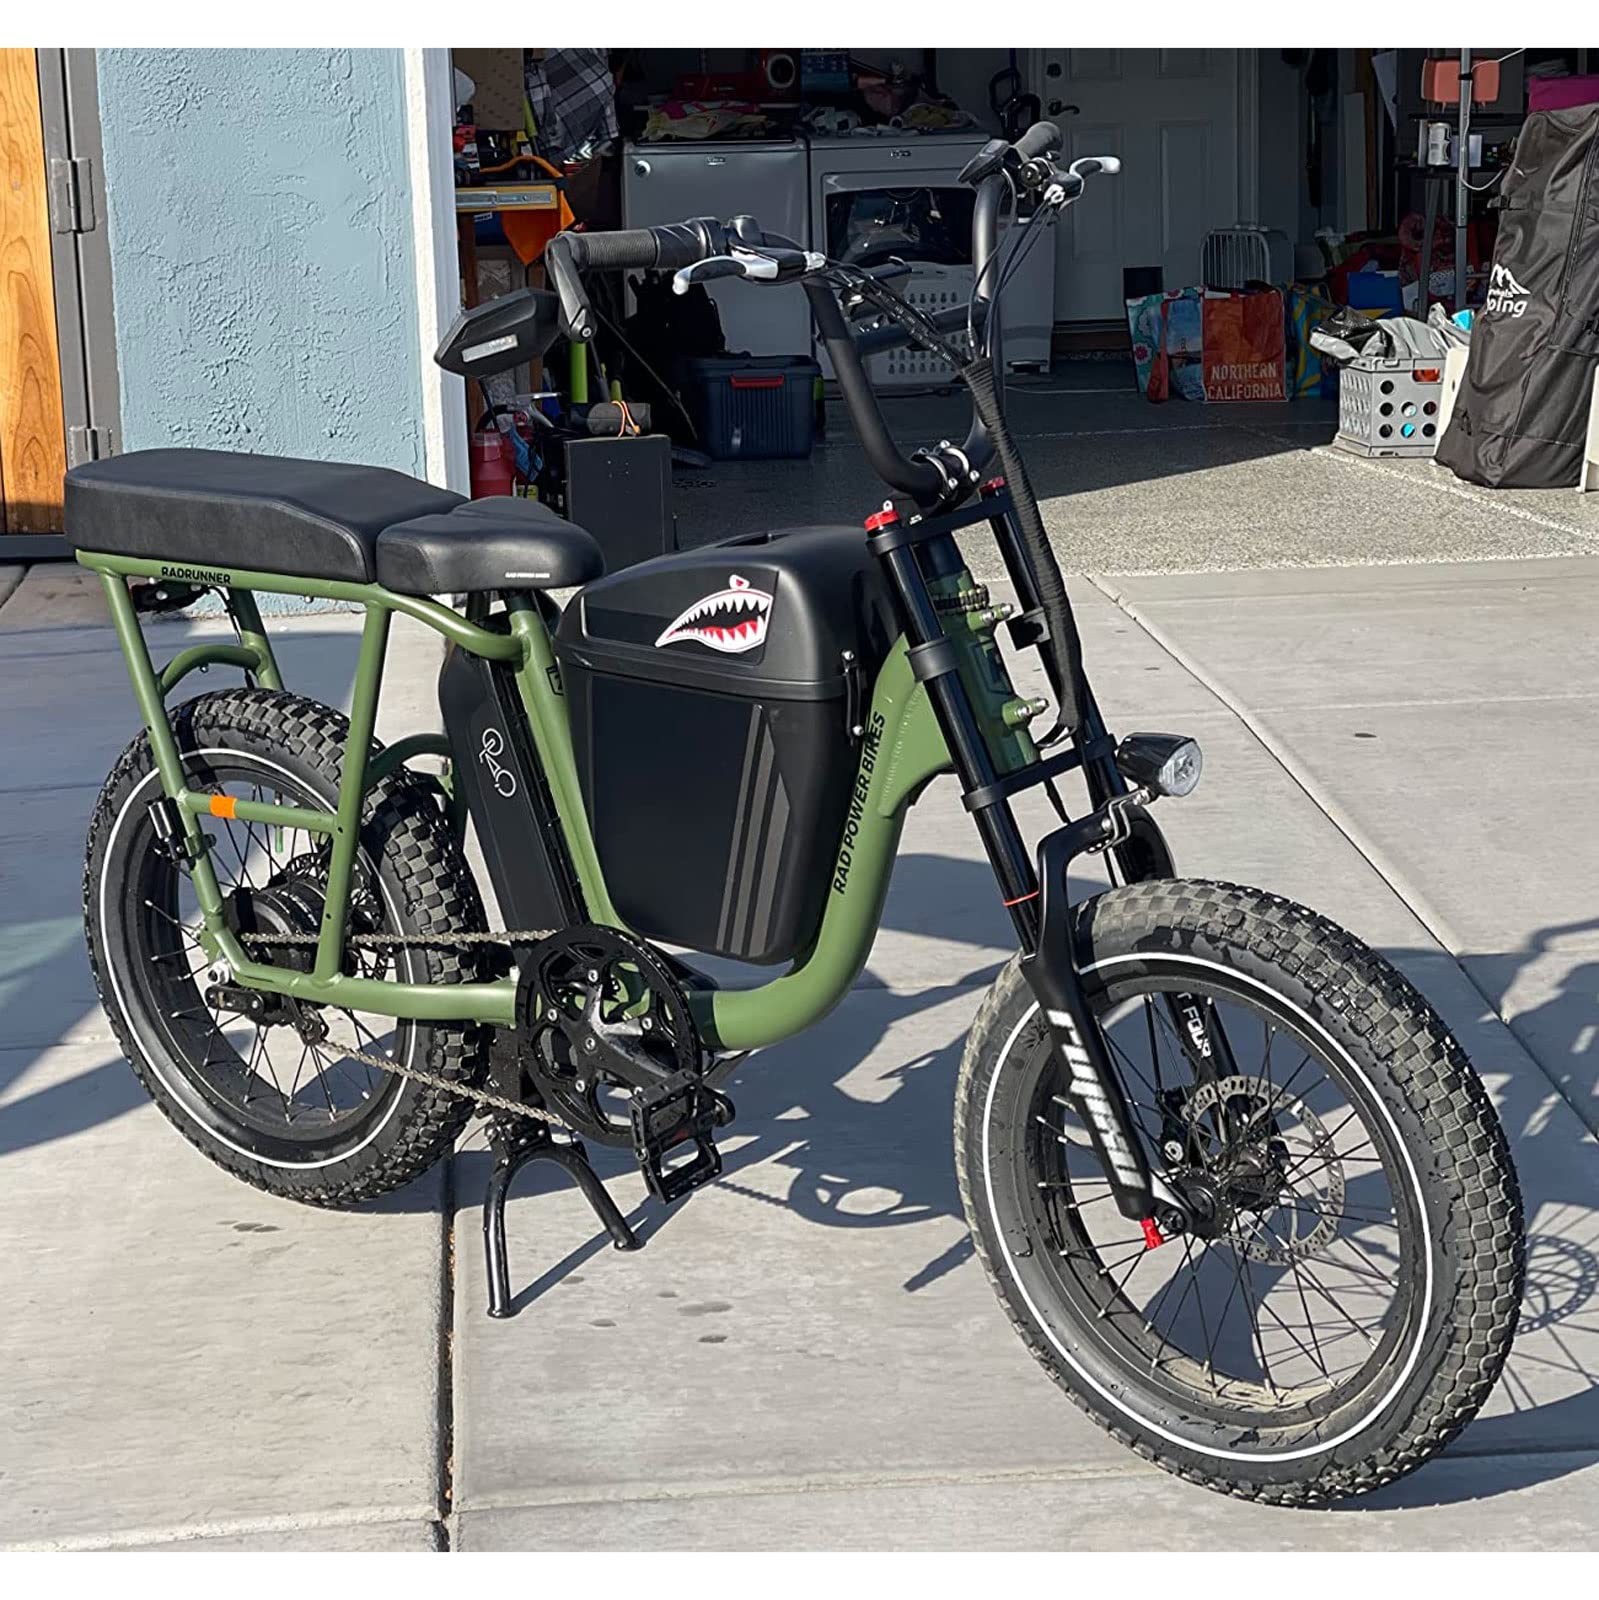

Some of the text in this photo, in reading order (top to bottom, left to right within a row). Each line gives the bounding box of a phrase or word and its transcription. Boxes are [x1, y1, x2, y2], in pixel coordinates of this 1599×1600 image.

[1211, 363, 1277, 381] NORTHERN
[1207, 383, 1283, 400] CALIFORNIA
[161, 567, 231, 584] RADRUNNER
[832, 711, 886, 894] RAD POWER BIKES
[1182, 1006, 1212, 1058] FOUR
